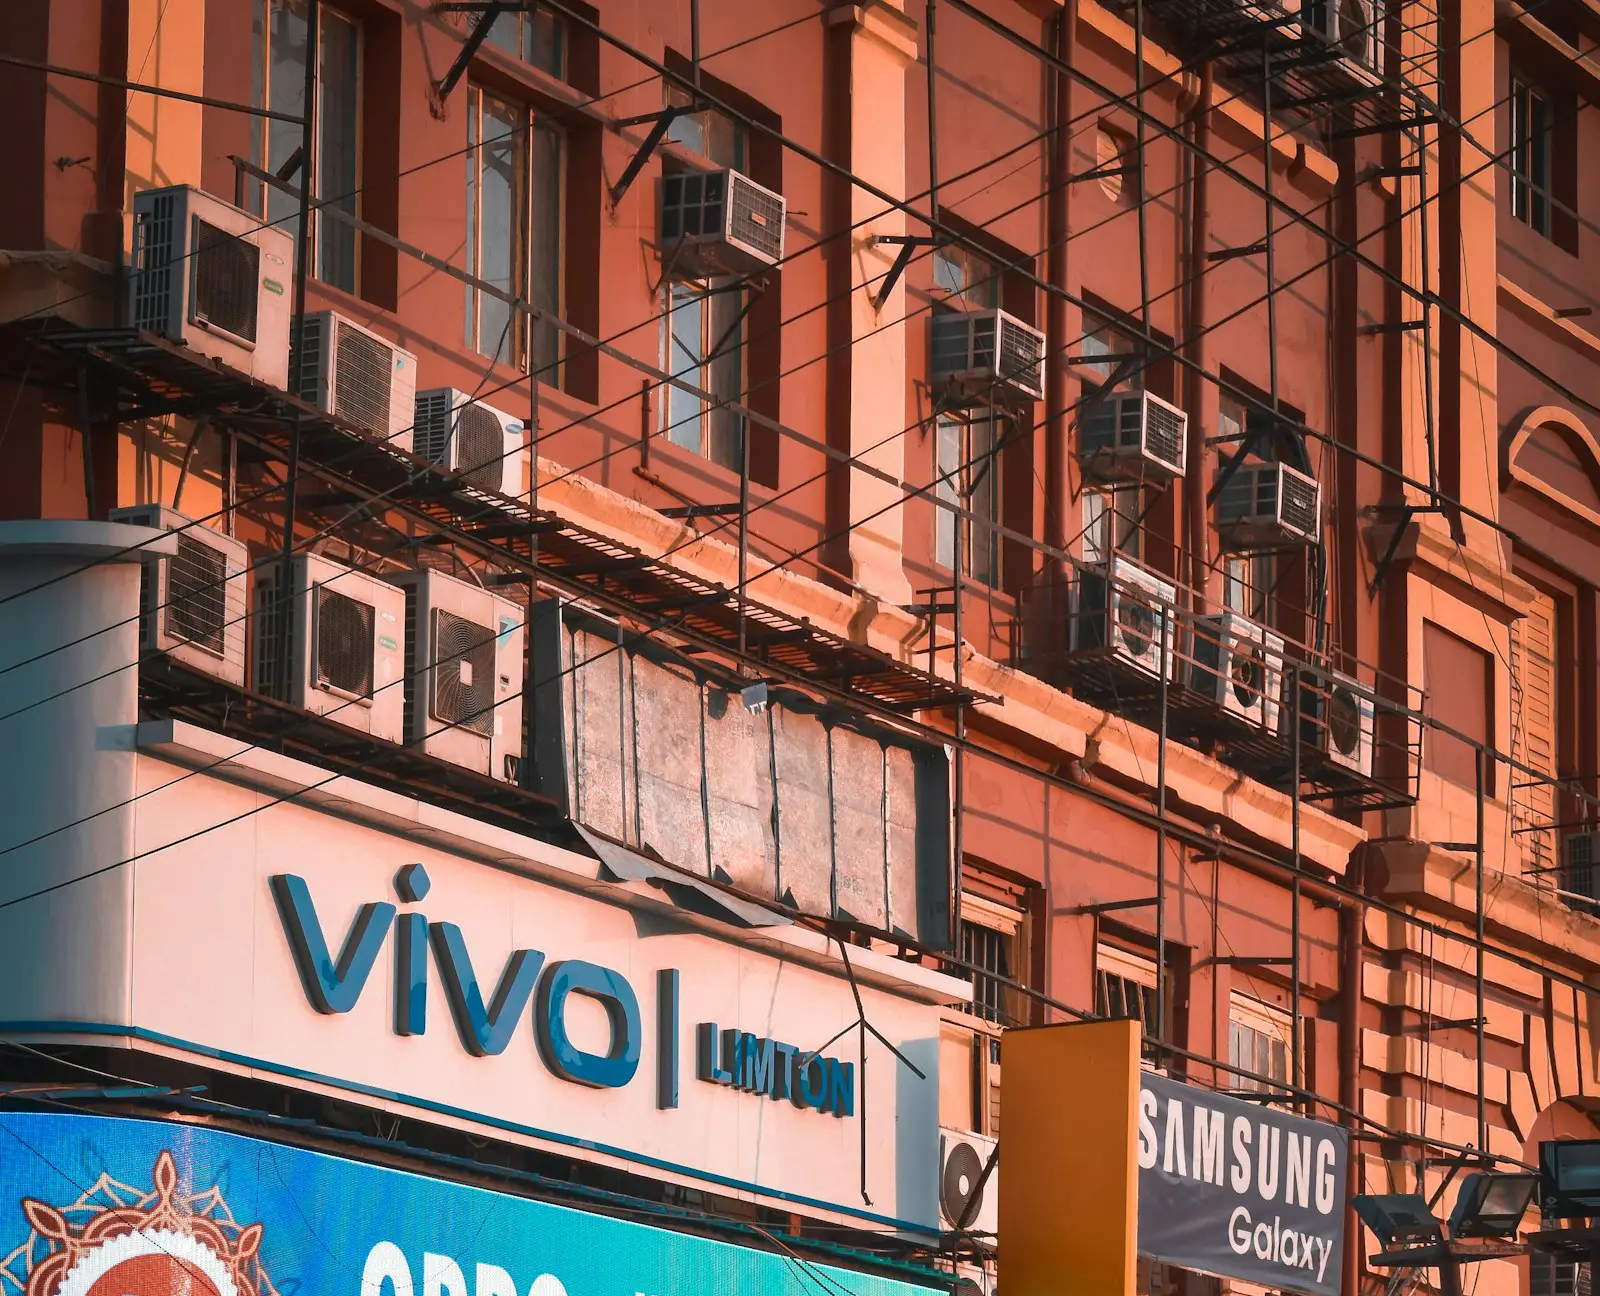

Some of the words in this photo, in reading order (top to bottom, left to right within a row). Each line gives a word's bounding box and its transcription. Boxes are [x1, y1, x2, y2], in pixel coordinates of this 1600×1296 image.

[268, 863, 642, 1088] vivo
[695, 1022, 855, 1118] LIMTON
[1138, 1088, 1336, 1215] SAMSUNG
[1228, 1206, 1333, 1283] Galaxy
